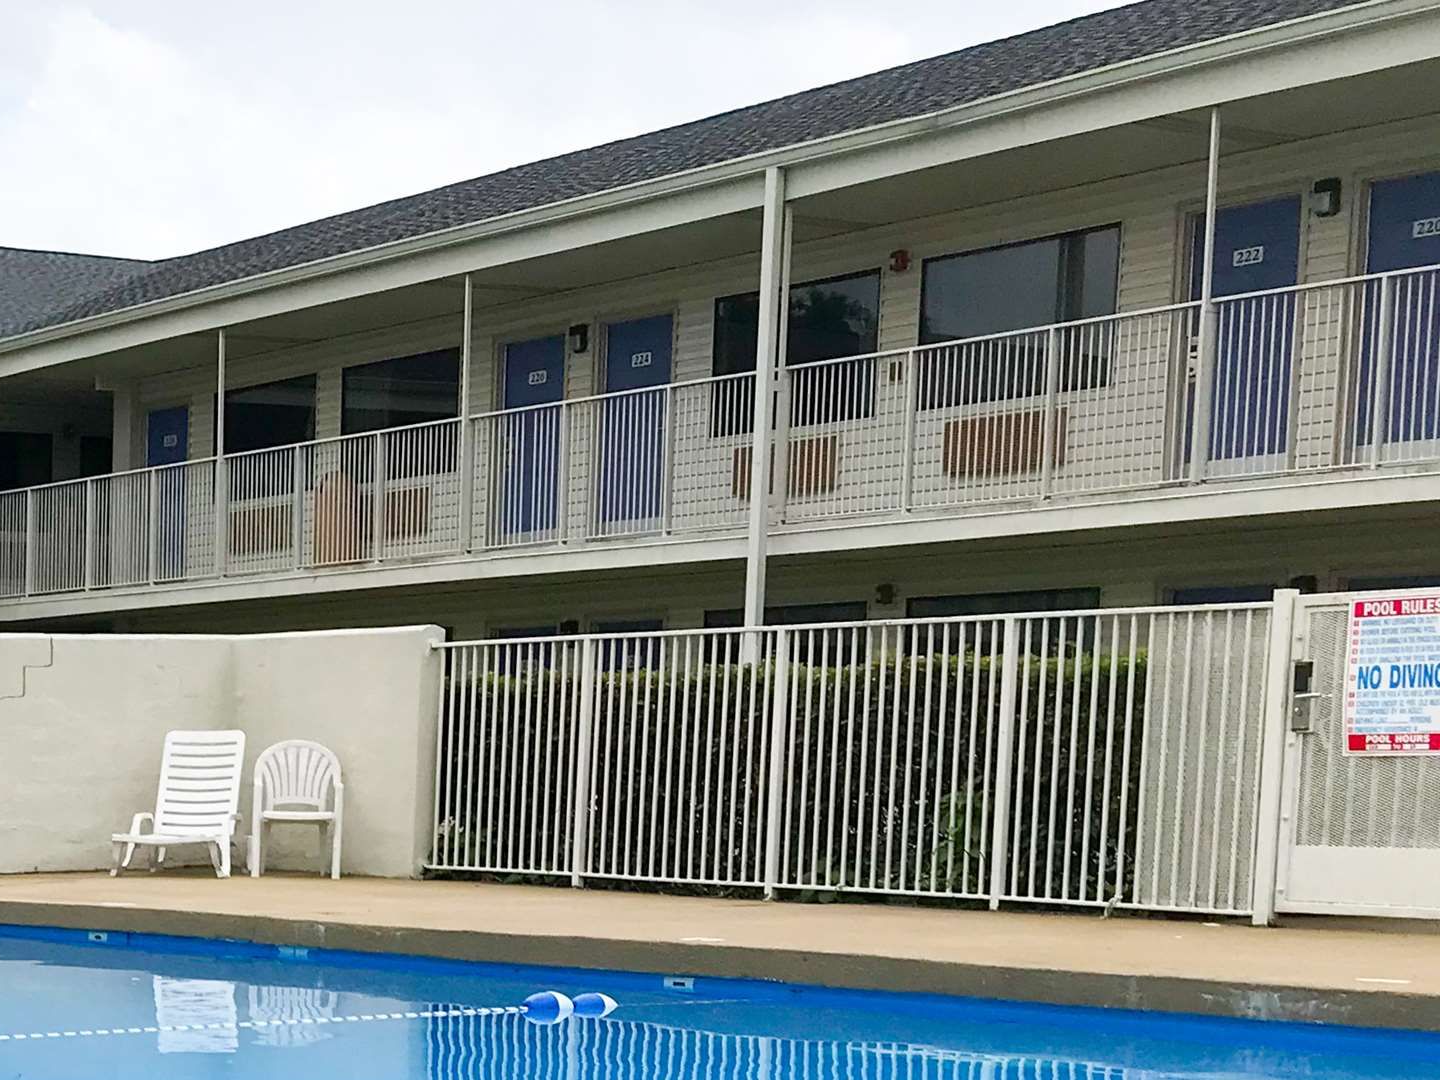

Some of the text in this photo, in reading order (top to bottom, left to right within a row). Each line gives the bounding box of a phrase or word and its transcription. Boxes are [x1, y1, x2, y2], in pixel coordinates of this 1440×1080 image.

[1235, 248, 1260, 264] 222
[1363, 602, 1397, 616] POOL
[1357, 665, 1382, 689] NO
[1365, 734, 1430, 743] POOL HOURS
